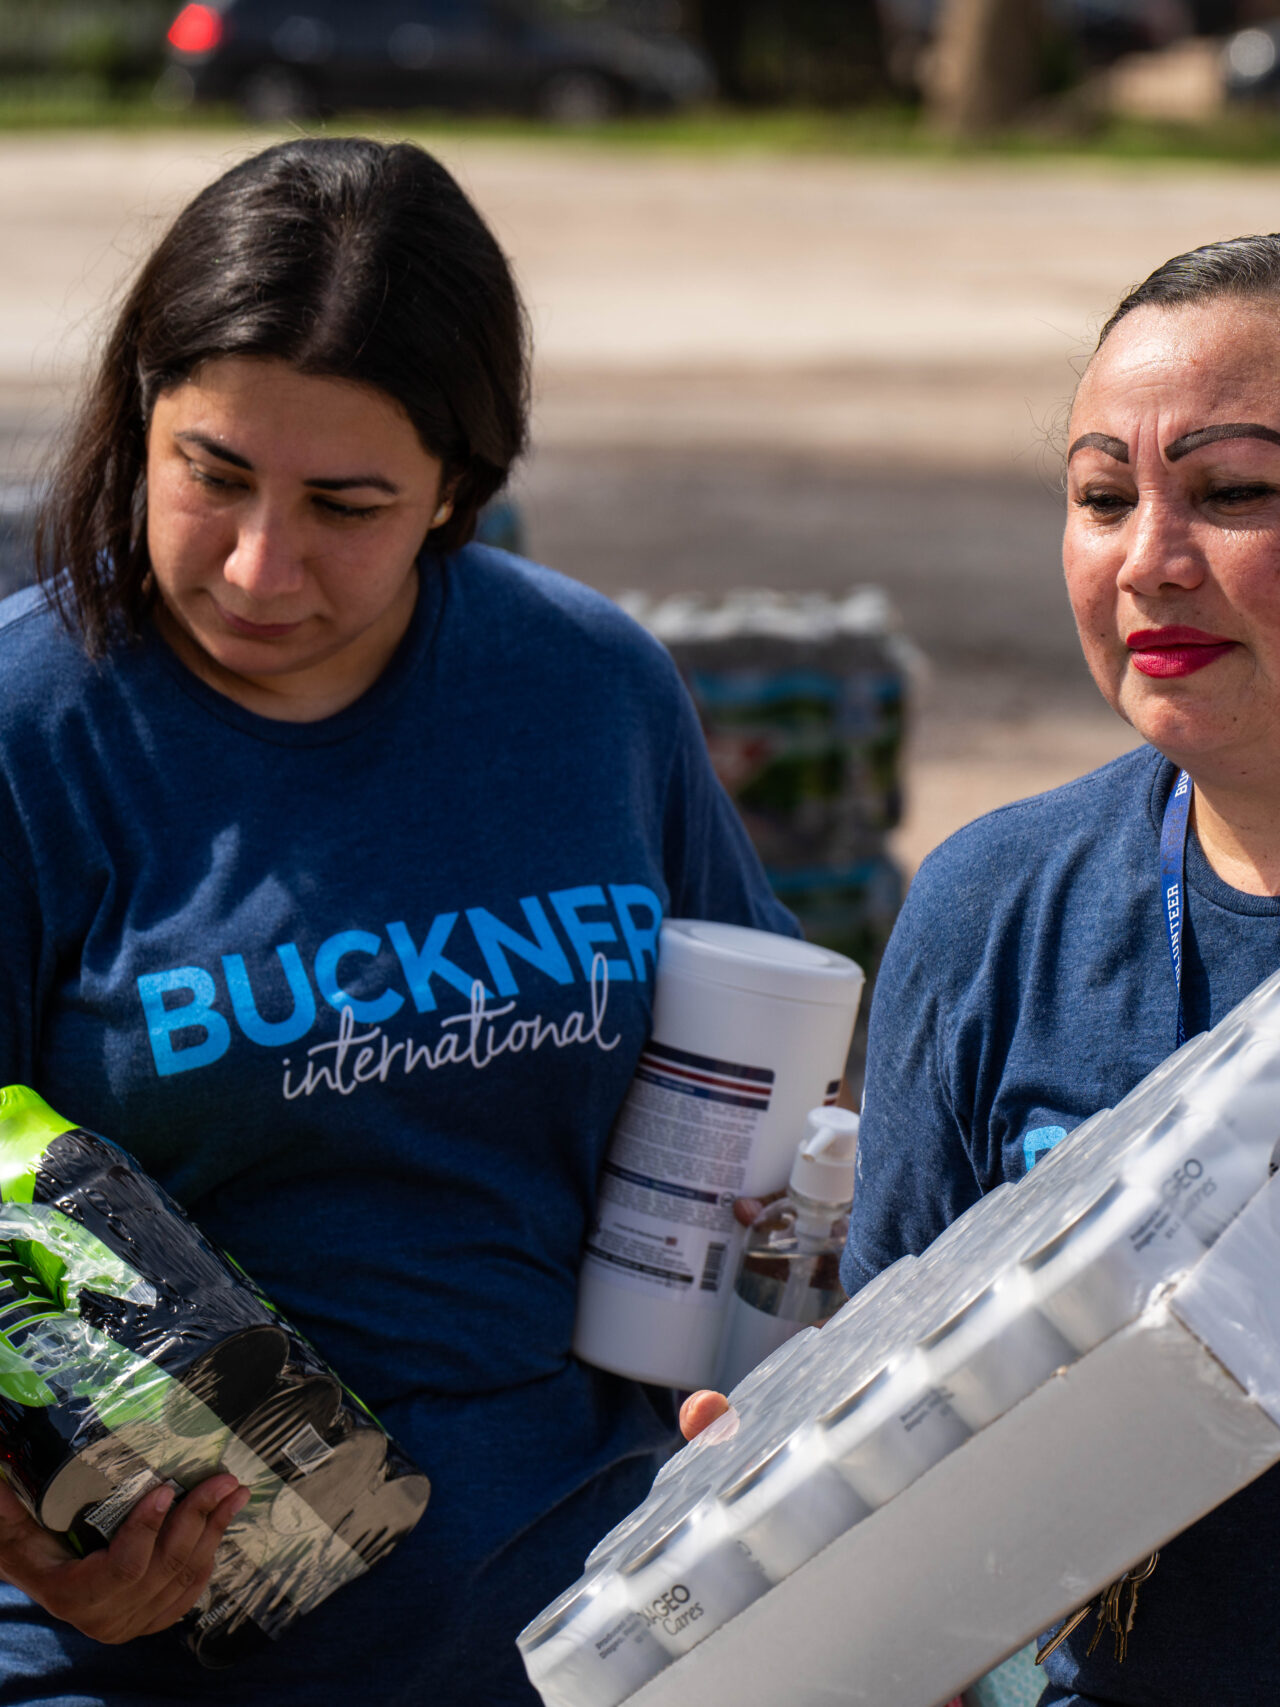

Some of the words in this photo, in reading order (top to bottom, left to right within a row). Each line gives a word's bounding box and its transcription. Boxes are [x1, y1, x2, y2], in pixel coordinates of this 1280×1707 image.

[137, 884, 663, 1077] BUCKNER
[1167, 883, 1182, 992] LUNTEER
[281, 952, 621, 1100] international
[662, 1602, 705, 1636] Cares
